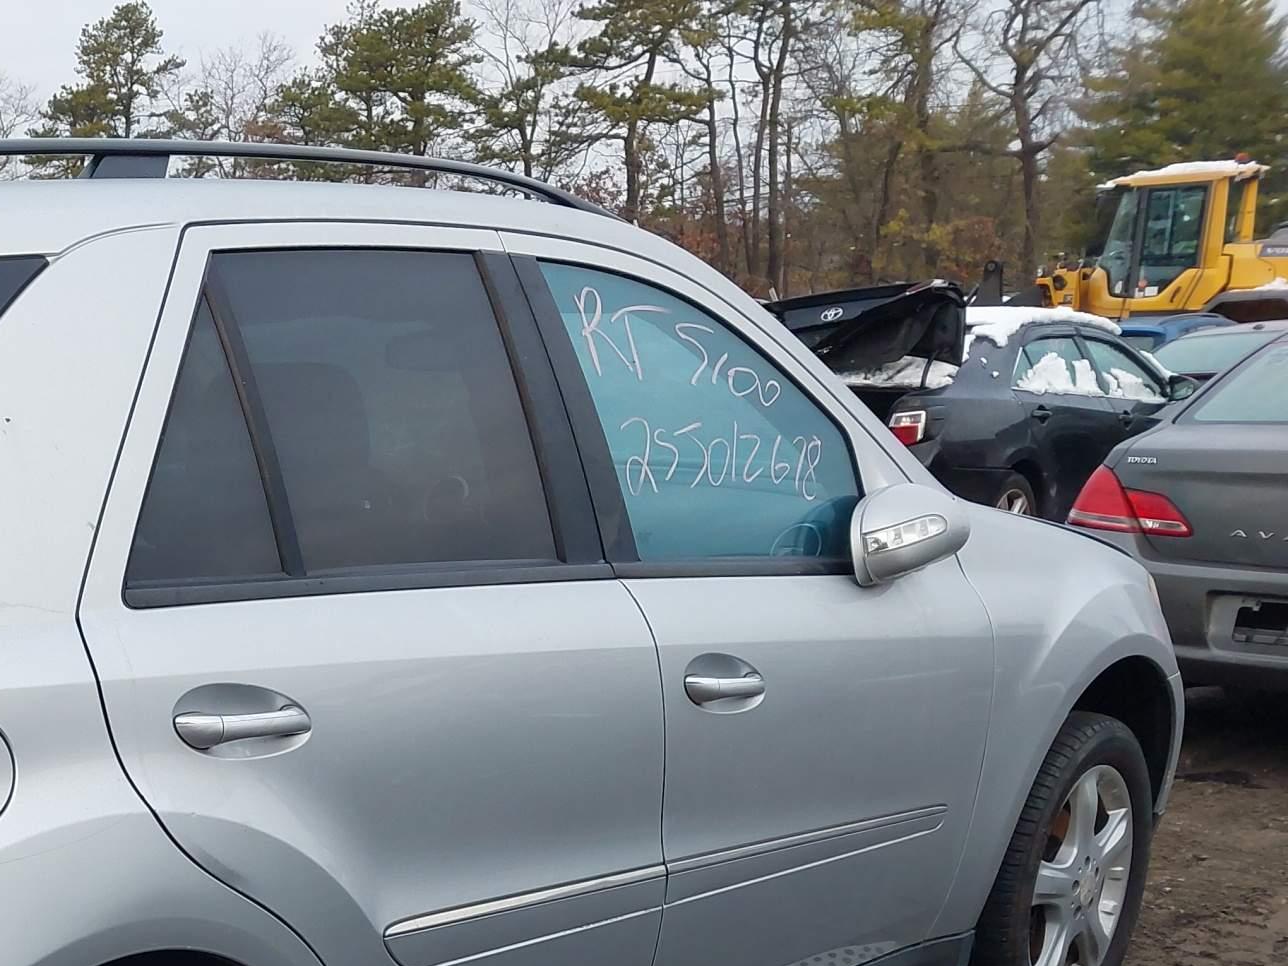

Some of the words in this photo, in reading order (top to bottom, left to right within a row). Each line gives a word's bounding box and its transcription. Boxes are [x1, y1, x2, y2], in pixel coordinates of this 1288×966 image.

[573, 286, 672, 381] RT
[674, 322, 782, 407] 5100
[1127, 456, 1157, 464] TOYOTA
